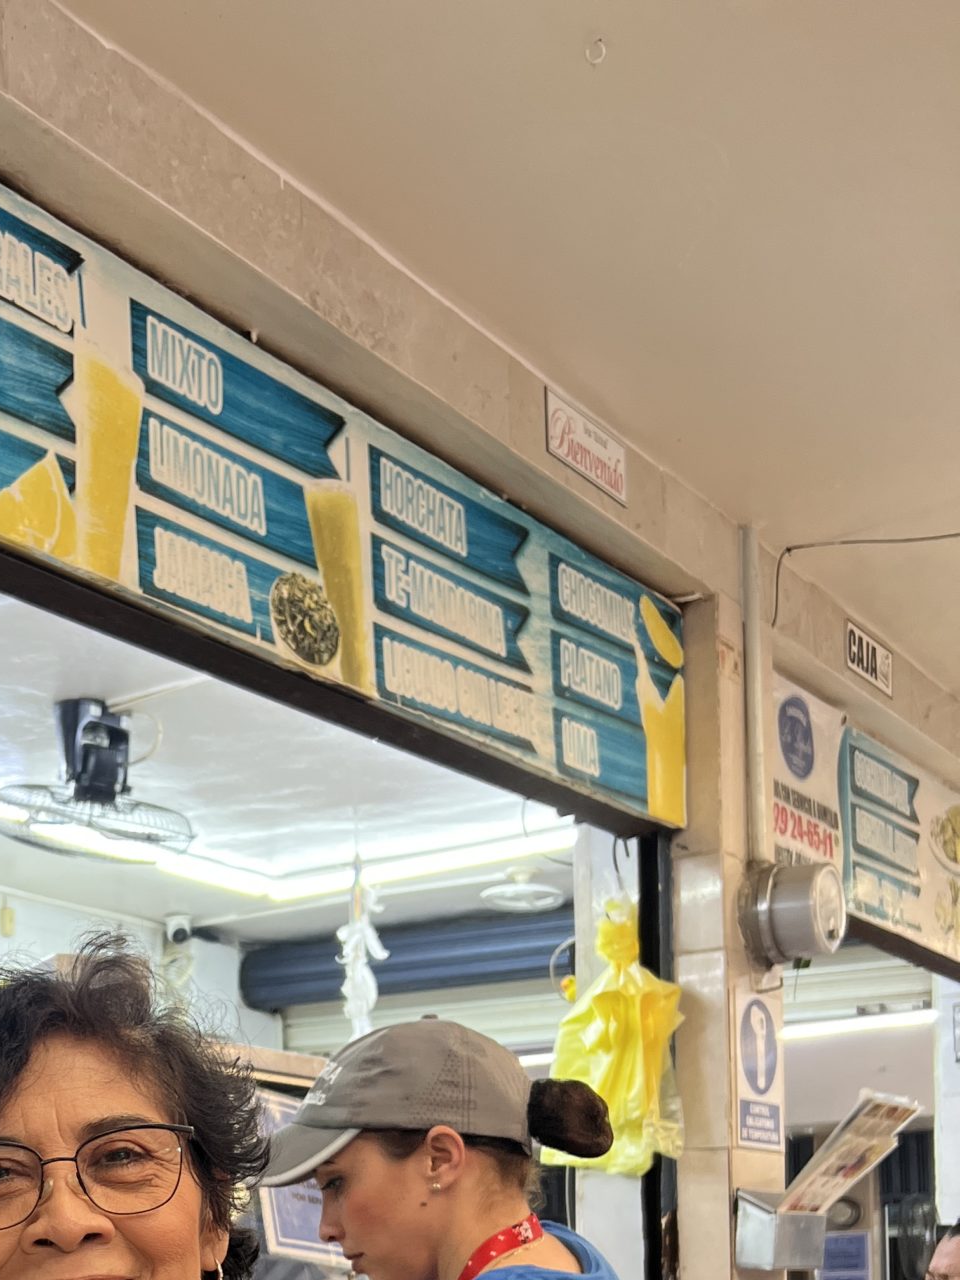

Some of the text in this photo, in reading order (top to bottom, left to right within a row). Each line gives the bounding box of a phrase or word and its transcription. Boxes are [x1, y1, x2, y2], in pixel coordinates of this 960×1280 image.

[146, 314, 224, 416] MIXTO
[148, 416, 268, 537] LIMONADA
[550, 407, 625, 497] Bienvenido
[379, 455, 468, 558] HORCHATA
[560, 636, 622, 711] PLATANO
[848, 628, 879, 681] CAJA
[560, 715, 601, 779] LIMA
